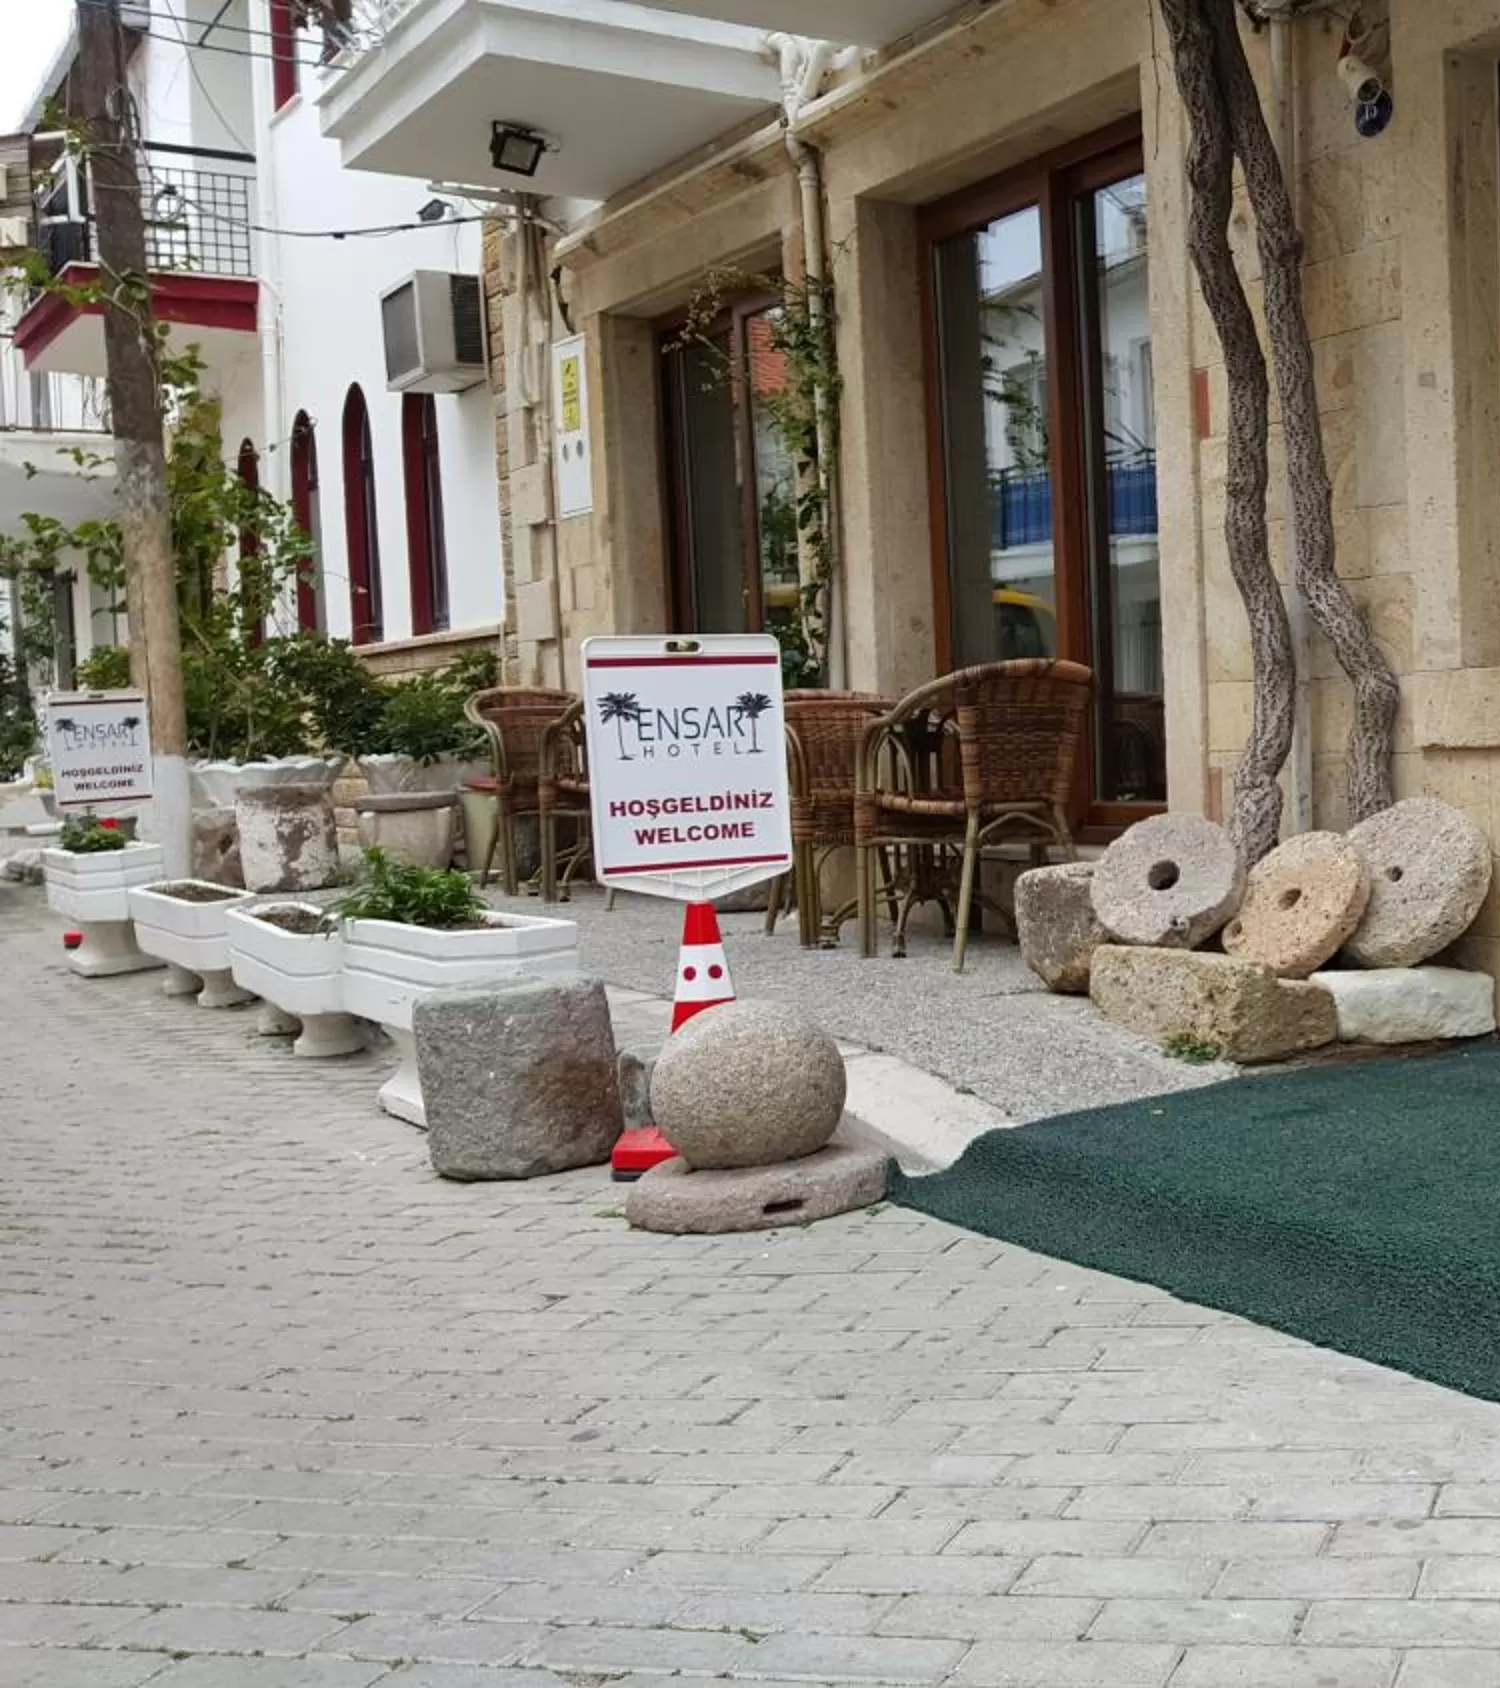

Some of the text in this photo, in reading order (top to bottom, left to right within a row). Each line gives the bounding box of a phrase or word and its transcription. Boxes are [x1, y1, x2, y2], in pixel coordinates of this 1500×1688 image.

[73, 722, 129, 742] ENSAR
[636, 705, 746, 742] ENSAR
[643, 741, 742, 759] HOTEL
[609, 789, 774, 819] HOŞGELDİNİZ
[634, 821, 756, 845] WELCOME
